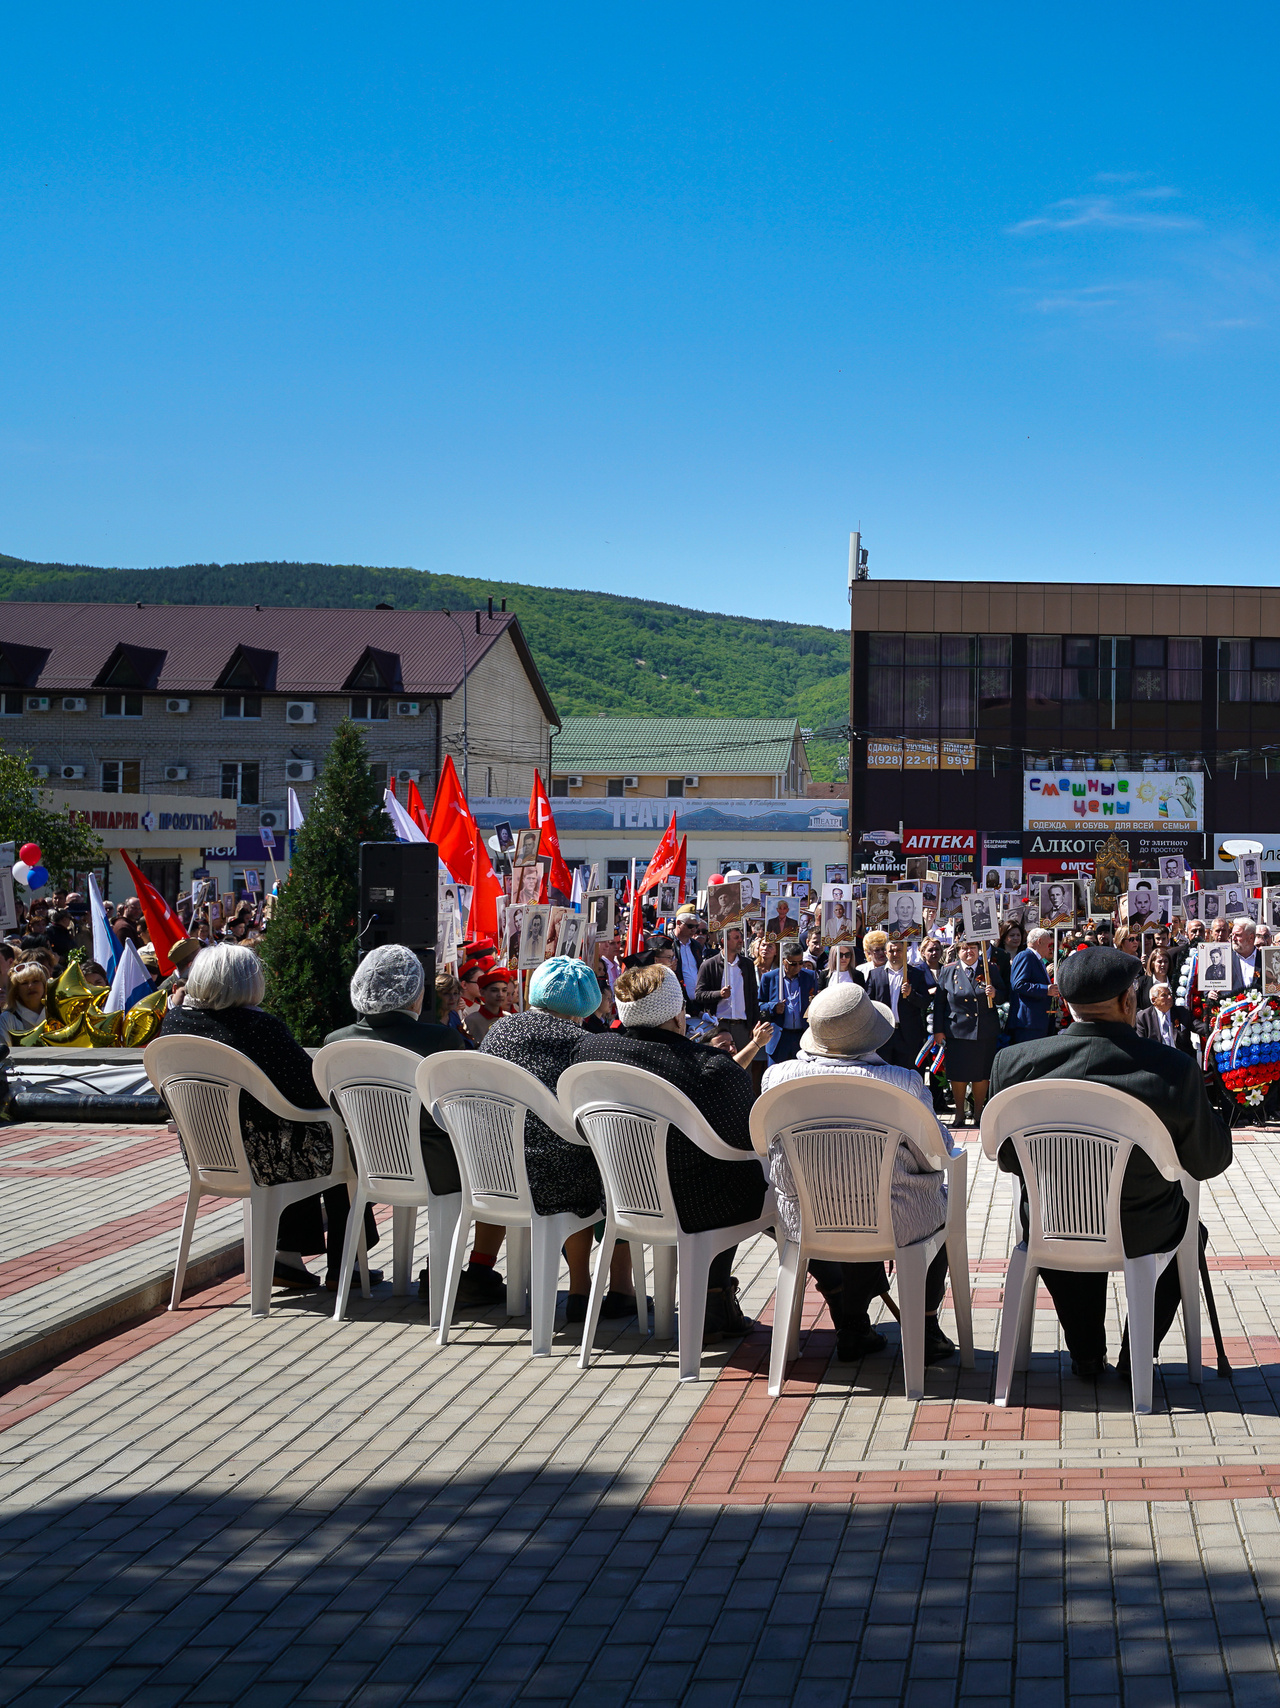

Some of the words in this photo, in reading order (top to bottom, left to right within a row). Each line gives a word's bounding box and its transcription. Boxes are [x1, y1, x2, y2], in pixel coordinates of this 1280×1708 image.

[943, 744, 974, 752] НОМЕРА
[867, 756, 902, 765] 8(928)
[906, 756, 938, 765] 22-11
[947, 756, 970, 765] 999
[609, 801, 685, 828] ТЕАТР
[159, 812, 212, 830] ПРОДУКТЫ
[1032, 821, 1067, 830] ОДЕЖДА
[1114, 822, 1132, 830] ДЛЯ
[1133, 820, 1154, 830] ВСЕЙ
[1162, 822, 1190, 830] СЕМЬИ
[905, 835, 974, 849] АПТЕКА
[1030, 836, 1131, 853] Алкотеа
[1139, 839, 1150, 847] От
[874, 849, 895, 857] КАФЕ
[861, 863, 907, 871] МИМИНО
[1068, 861, 1094, 870] МТС
